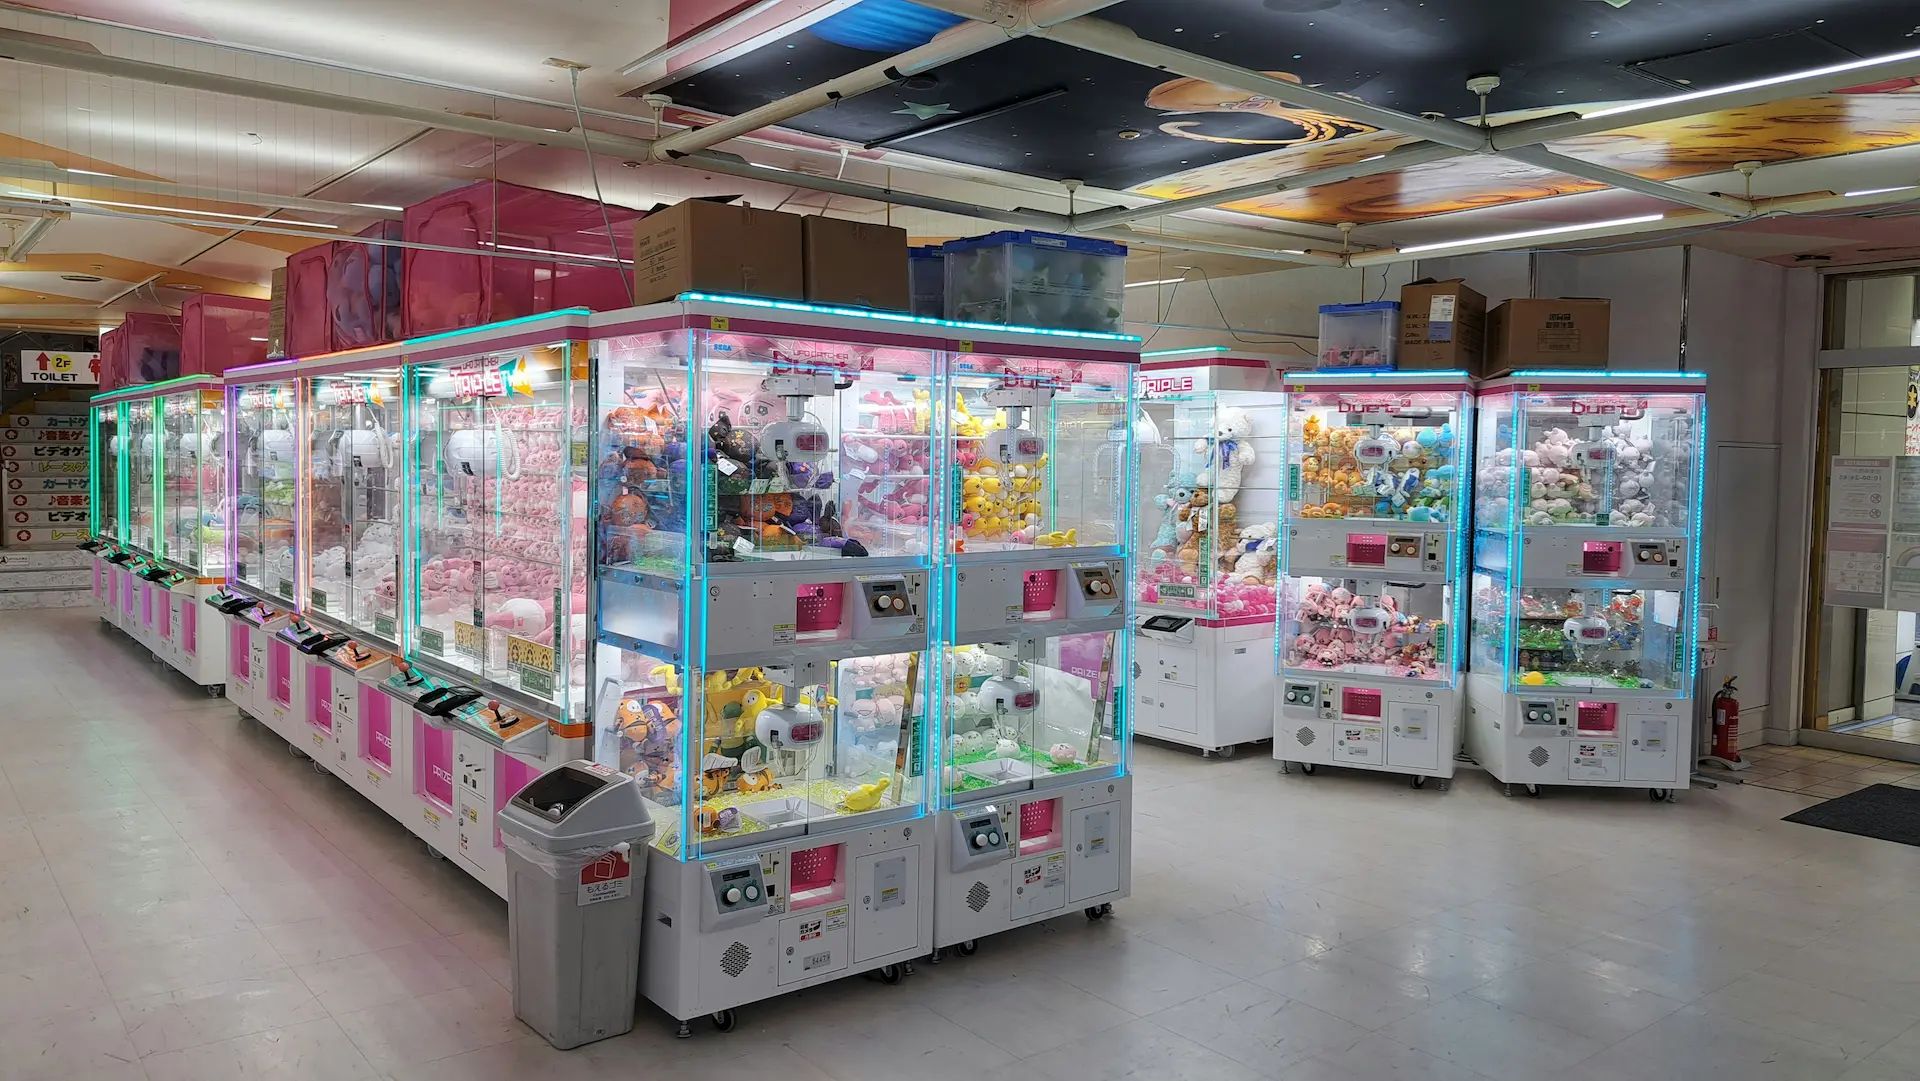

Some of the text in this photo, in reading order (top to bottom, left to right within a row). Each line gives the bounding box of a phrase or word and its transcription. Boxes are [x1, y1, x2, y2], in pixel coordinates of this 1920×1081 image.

[56, 357, 72, 368] 2F
[30, 372, 79, 382] TOILET
[1135, 375, 1193, 394] TRIPLE
[1071, 666, 1098, 679] PRIZE
[432, 764, 453, 785] PRIZE
[587, 880, 624, 893] もえるゴミ
